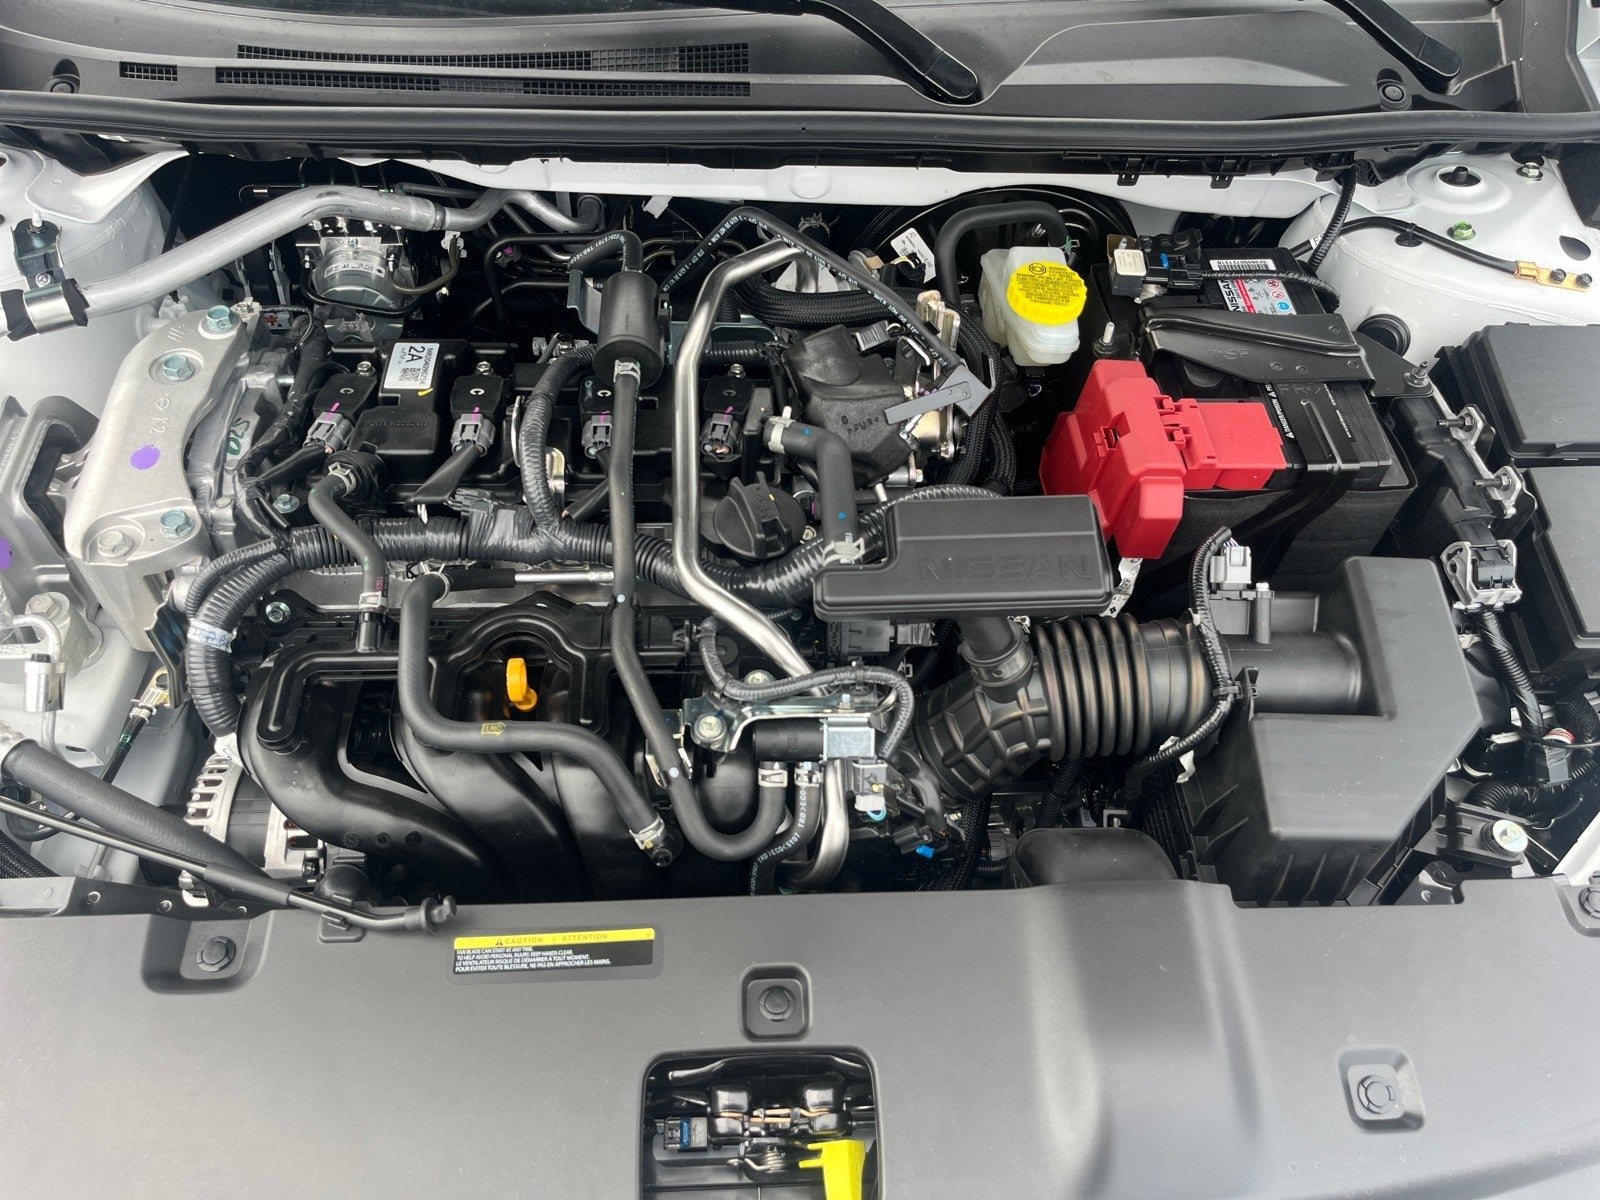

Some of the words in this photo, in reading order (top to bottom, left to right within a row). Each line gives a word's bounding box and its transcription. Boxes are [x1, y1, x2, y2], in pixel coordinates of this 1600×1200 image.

[406, 346, 426, 362] 2A
[920, 554, 1093, 583] NISSAN
[504, 937, 544, 945] CAUTION
[562, 934, 608, 942] ATTENTION
